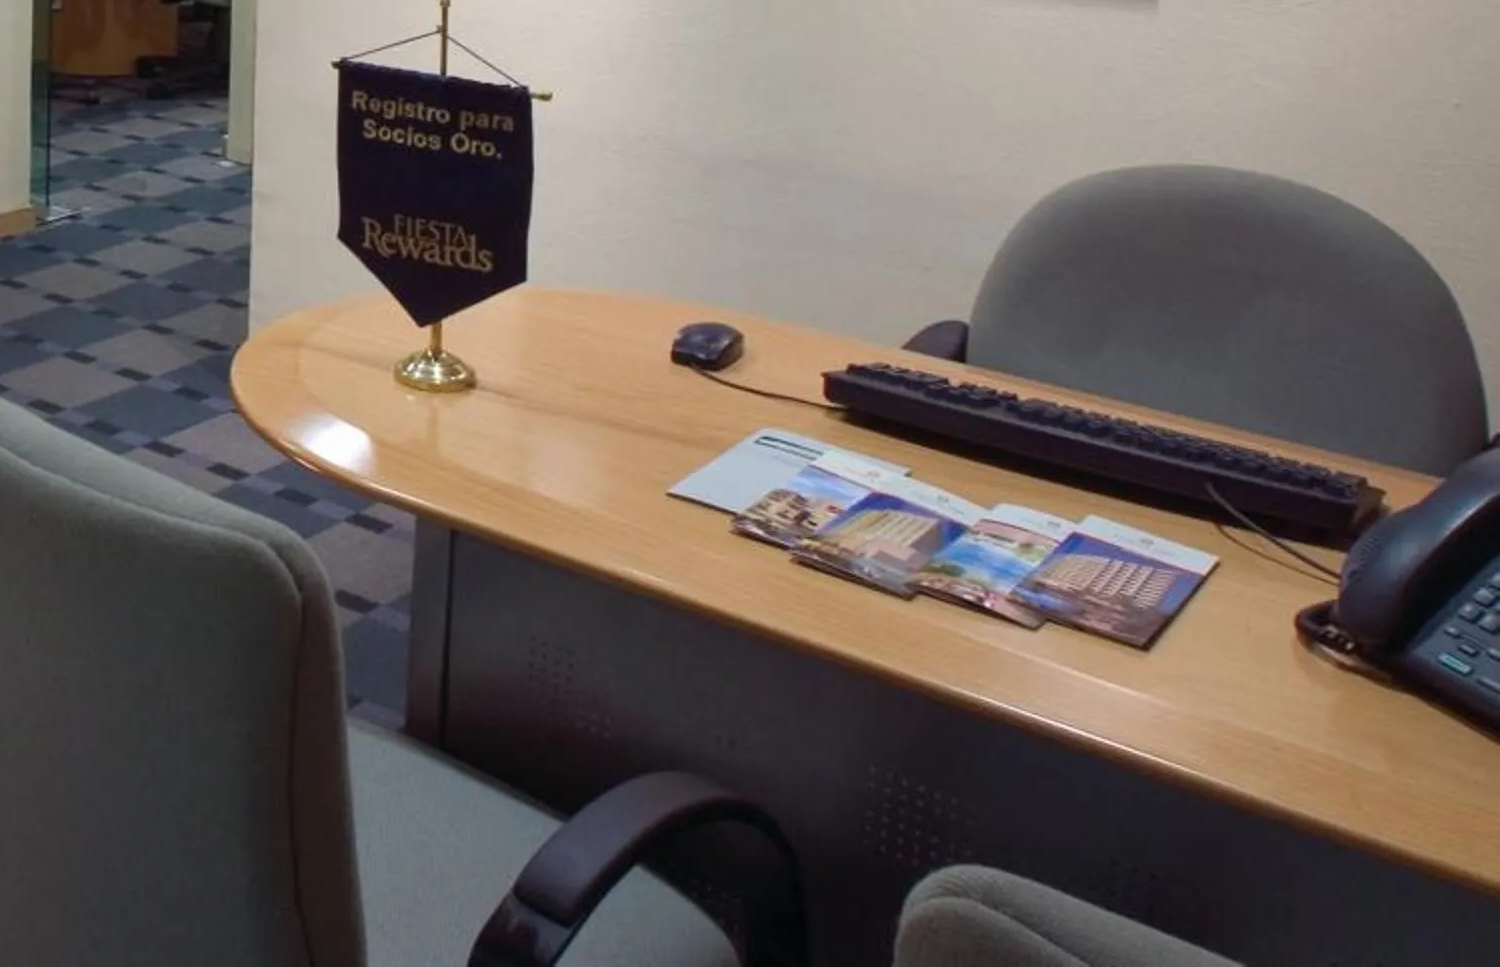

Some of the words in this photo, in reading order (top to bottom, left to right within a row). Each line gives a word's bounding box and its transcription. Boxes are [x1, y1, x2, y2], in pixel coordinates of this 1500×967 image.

[352, 90, 450, 123] Registro
[459, 110, 514, 131] para
[363, 119, 442, 150] Socios
[450, 133, 503, 159] Oro.
[361, 217, 494, 273] Rewards
[394, 213, 469, 247] FIESTA
